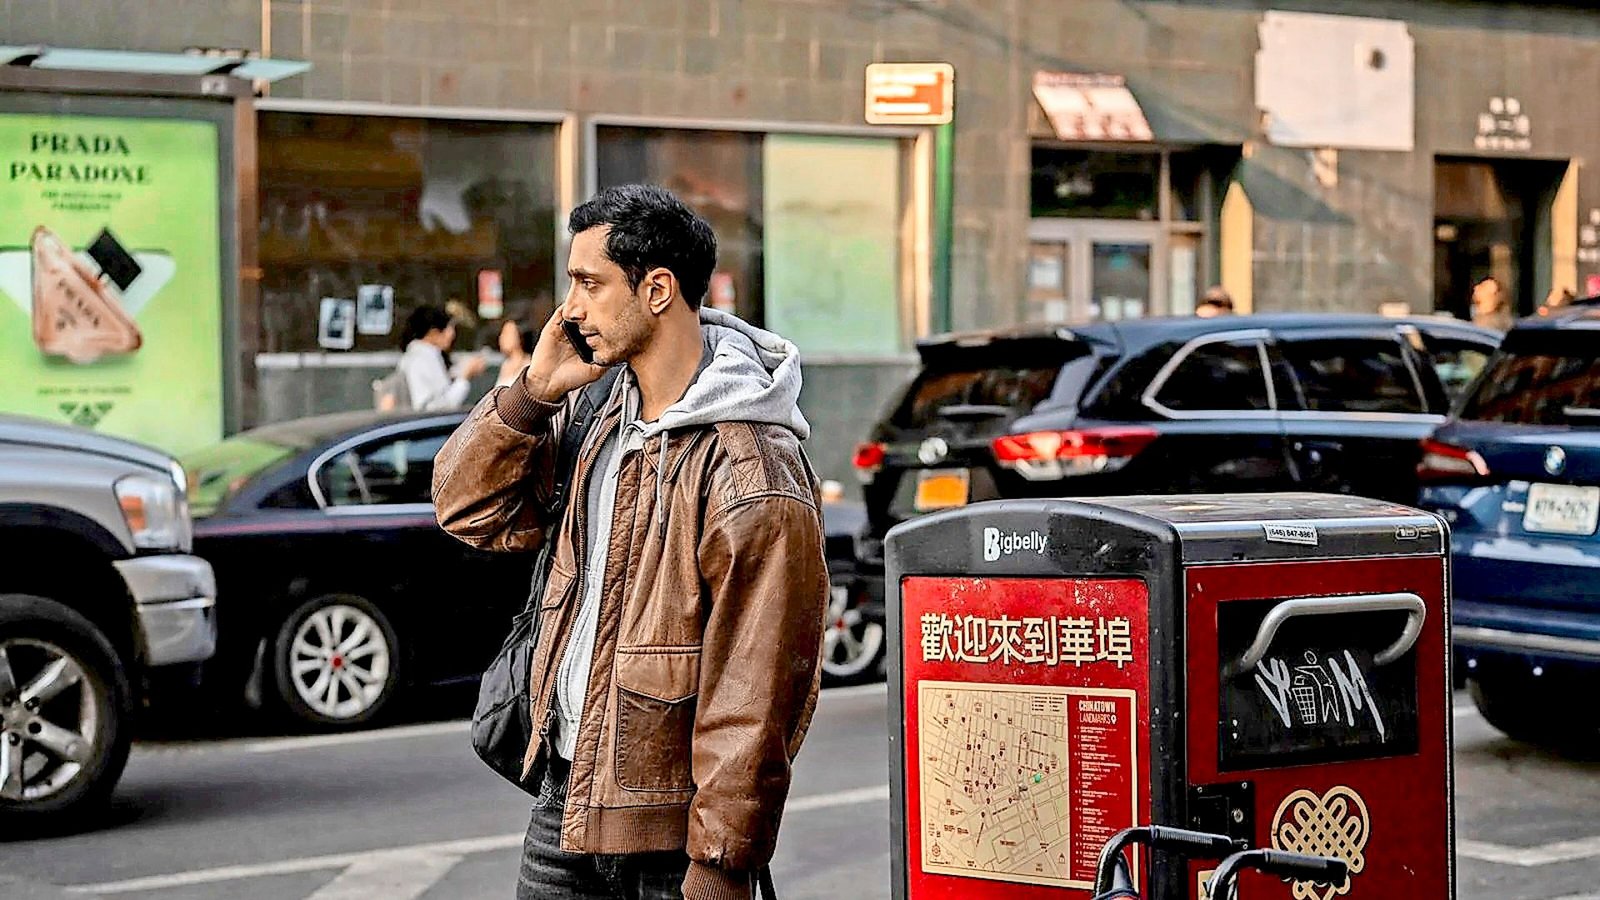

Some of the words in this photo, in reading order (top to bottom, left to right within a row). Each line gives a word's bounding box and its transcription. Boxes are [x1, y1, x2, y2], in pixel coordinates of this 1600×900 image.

[31, 132, 129, 156] PRADA
[984, 527, 1047, 561] Bigbelly
[920, 612, 1133, 669] 歡迎來到華埠
[1079, 700, 1116, 713] CHINATOWN
[1080, 713, 1111, 725] LANDMARKS
